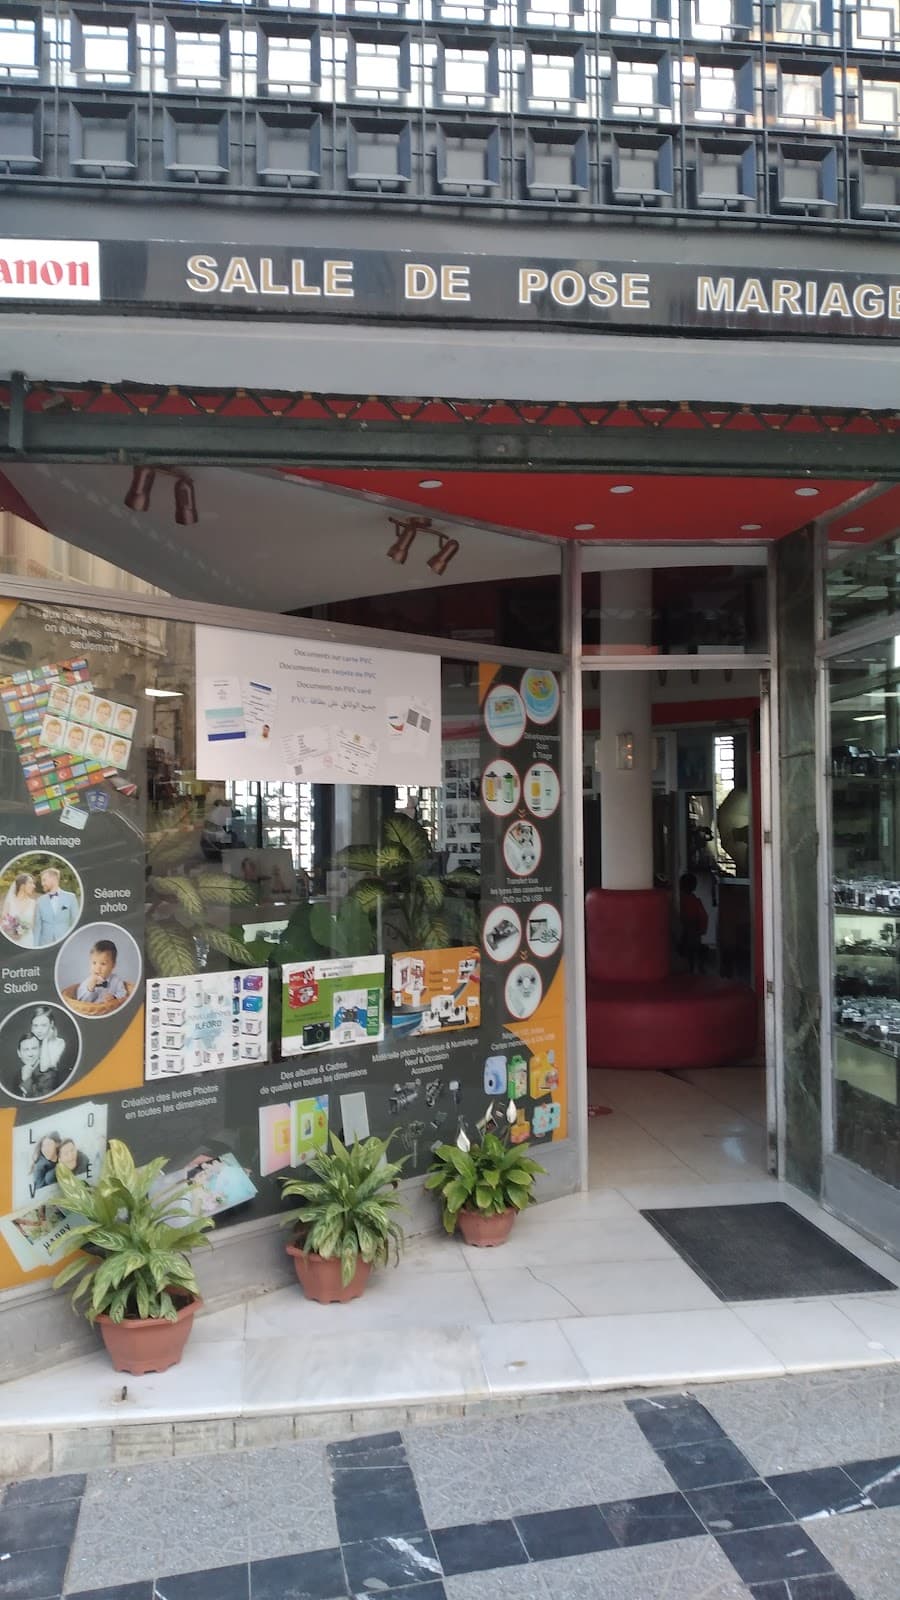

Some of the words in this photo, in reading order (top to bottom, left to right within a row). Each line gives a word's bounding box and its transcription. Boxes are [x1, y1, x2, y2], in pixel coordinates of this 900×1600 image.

[0, 258, 90, 287] anon
[185, 254, 354, 297] SALLE
[404, 262, 471, 302] DE
[518, 267, 651, 309] POSE
[59, 624, 103, 640] quelques
[70, 640, 119, 652] seulement
[294, 648, 330, 659] Documents
[359, 656, 374, 664] PVC
[279, 661, 320, 672] Documentos
[364, 671, 376, 679] PVC
[296, 680, 333, 691] Documents
[344, 685, 356, 693] PVC
[0, 835, 38, 846] Portrait
[39, 835, 81, 848] Mariage
[94, 887, 131, 899] Séance
[100, 902, 128, 914] photo
[2, 966, 40, 979] Portrait
[3, 981, 38, 994] Studio
[195, 1019, 222, 1031] ILFORD
[405, 1056, 418, 1066] Neuf
[280, 1071, 294, 1080] Des
[295, 1067, 318, 1078] albums
[319, 1065, 324, 1073] &
[325, 1062, 348, 1072] Cadres
[260, 1086, 269, 1095] de
[270, 1081, 292, 1094] qualité
[293, 1081, 302, 1089] en
[303, 1077, 322, 1087] toutes
[323, 1075, 333, 1083] les
[333, 1069, 368, 1081] dimensions
[121, 1095, 155, 1108] Création
[156, 1092, 170, 1102] des
[172, 1089, 192, 1100] livres
[193, 1085, 219, 1096] Photos
[125, 1111, 136, 1120] en
[137, 1106, 161, 1118] toutes
[163, 1104, 174, 1113] les
[175, 1096, 217, 1110] dimensions
[29, 1128, 36, 1144] L
[29, 1184, 37, 1198] V
[86, 1163, 93, 1178] E
